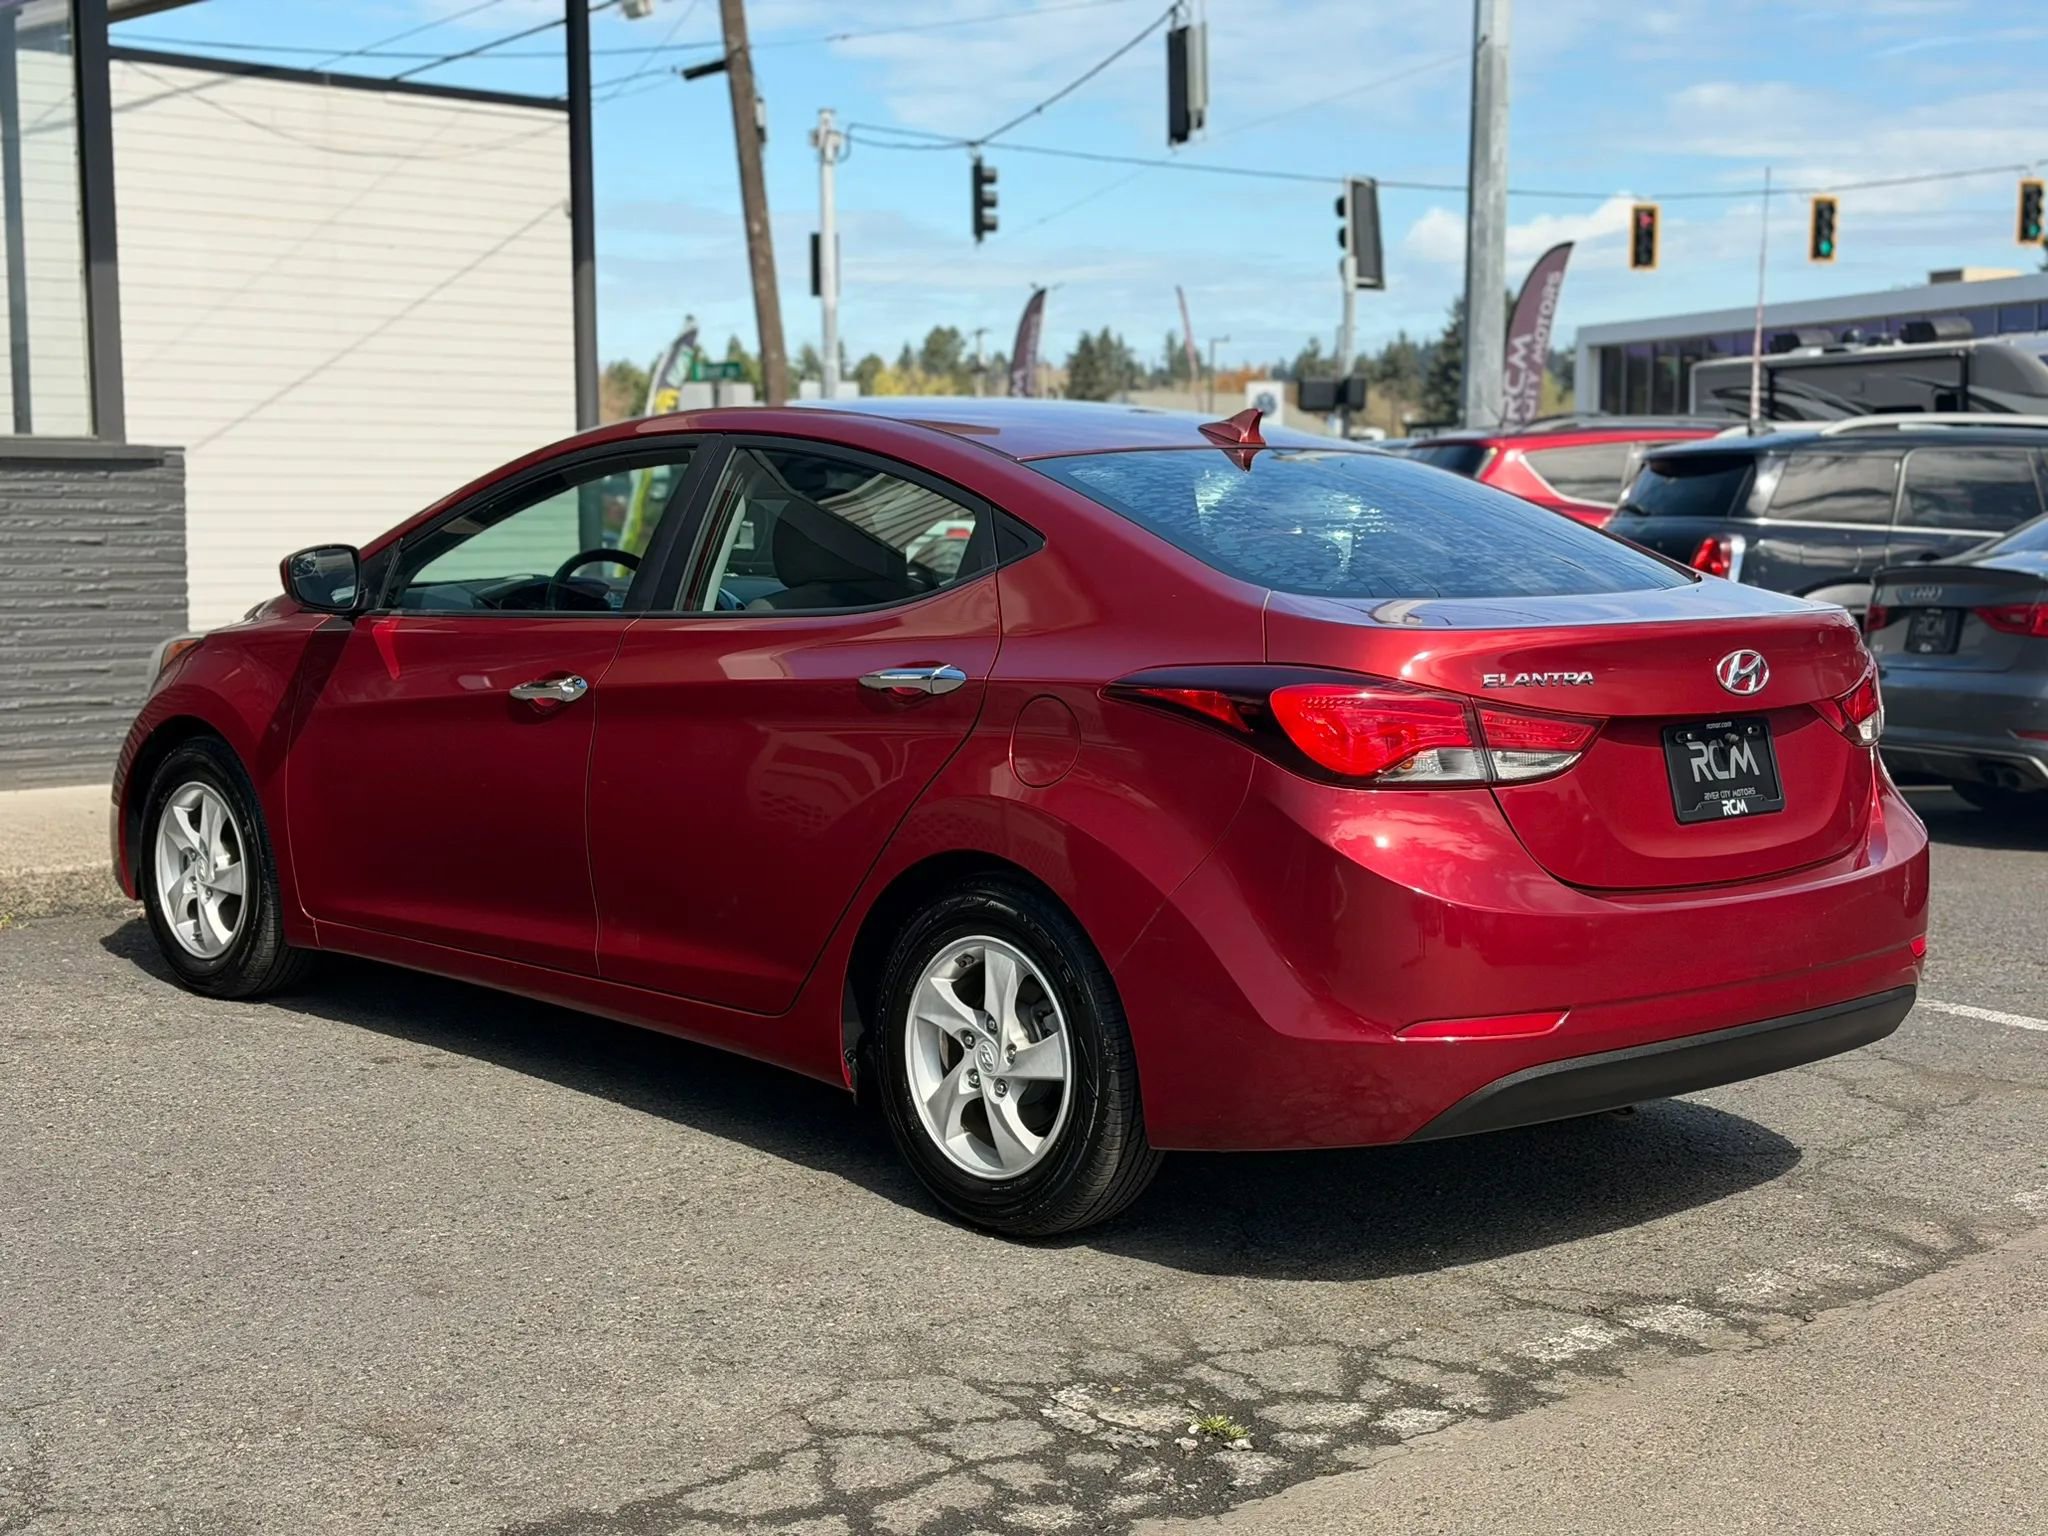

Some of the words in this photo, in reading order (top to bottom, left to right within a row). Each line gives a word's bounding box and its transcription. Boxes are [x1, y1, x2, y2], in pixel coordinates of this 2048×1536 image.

[1531, 271, 1563, 364] MOTORS
[1503, 333, 1533, 421] RCM
[1482, 671, 1594, 688] ELANTRA
[1686, 738, 1760, 782] RCM
[1704, 792, 1720, 800] RIVER
[1720, 790, 1731, 799] CITY
[1732, 787, 1756, 797] MOTORS
[1721, 799, 1748, 816] RCM
